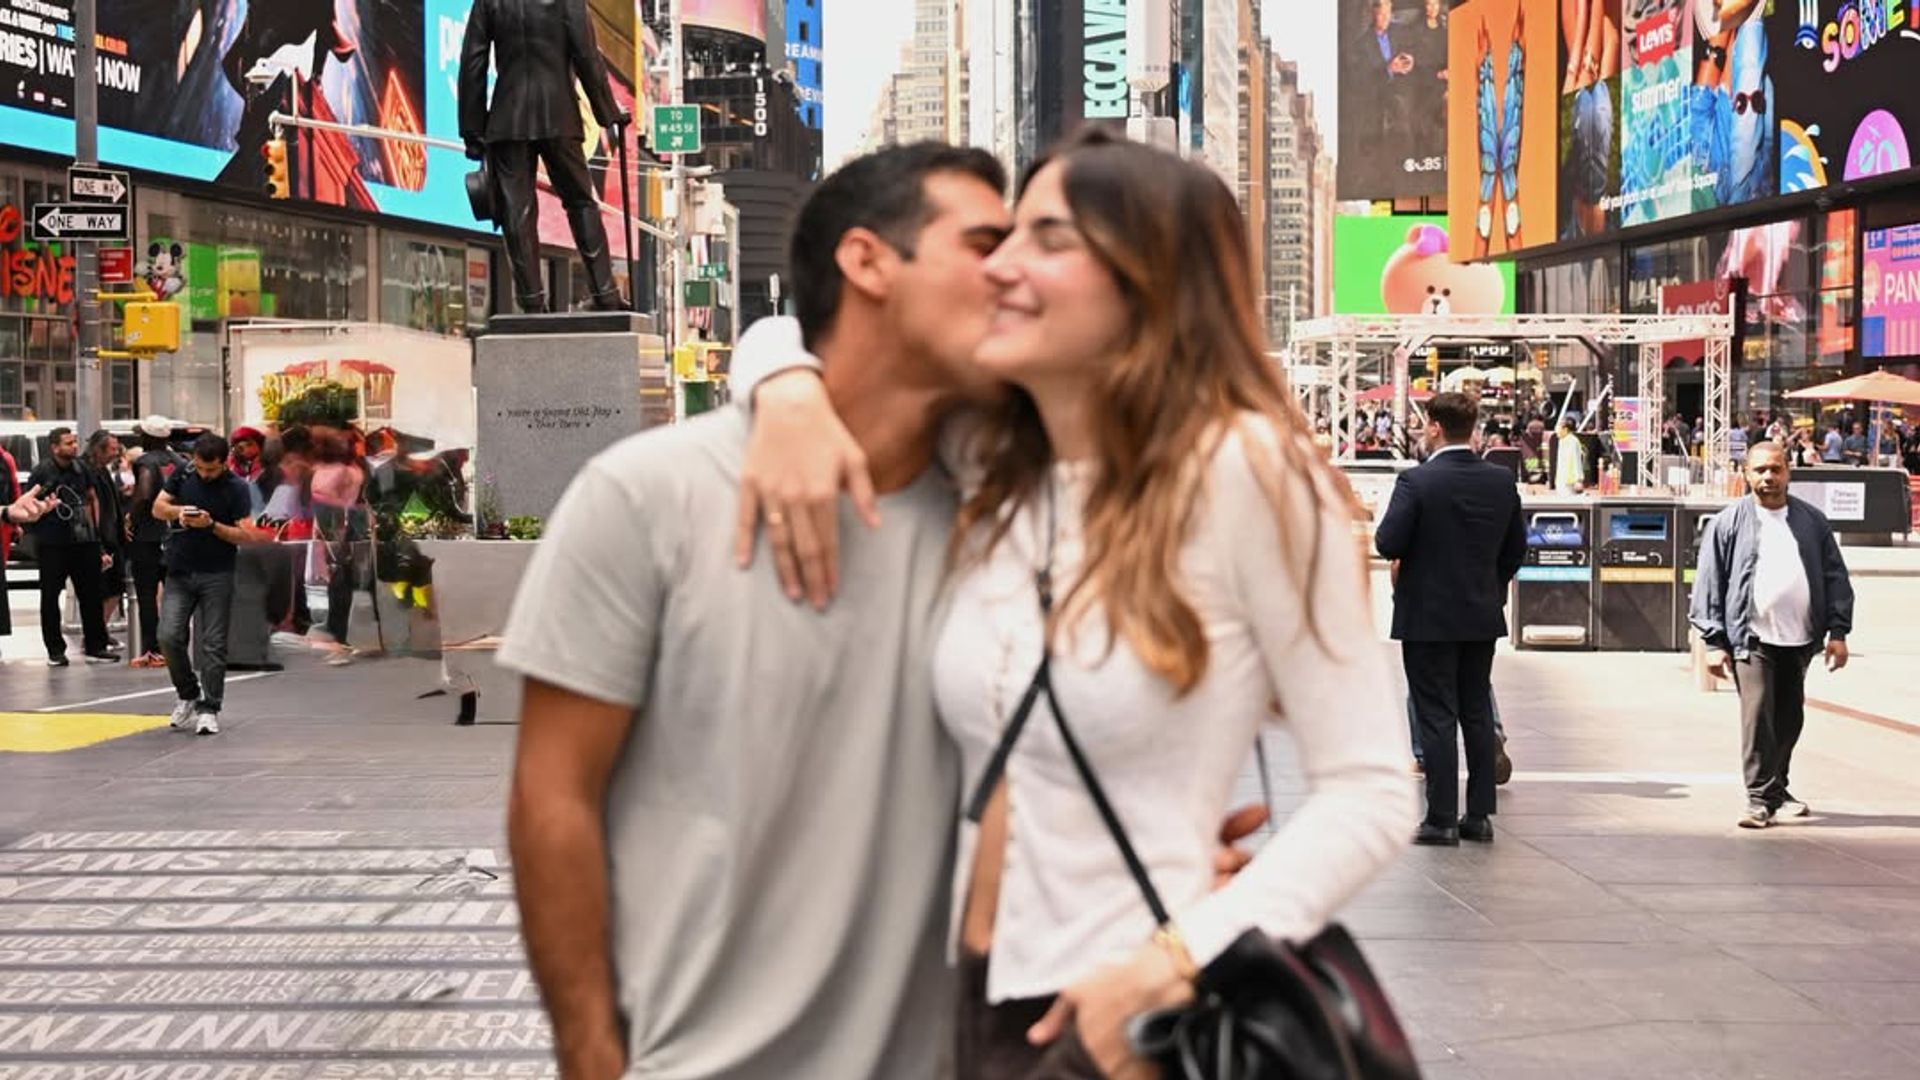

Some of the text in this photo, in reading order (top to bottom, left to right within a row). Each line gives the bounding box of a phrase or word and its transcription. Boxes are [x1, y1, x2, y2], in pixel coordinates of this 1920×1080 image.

[104, 57, 141, 93] NOW
[754, 78, 767, 136] 1500
[1631, 78, 1680, 115] summer
[77, 180, 120, 195] ONE WAY
[48, 215, 115, 229] ONE WAY
[1, 249, 75, 305] ISNE
